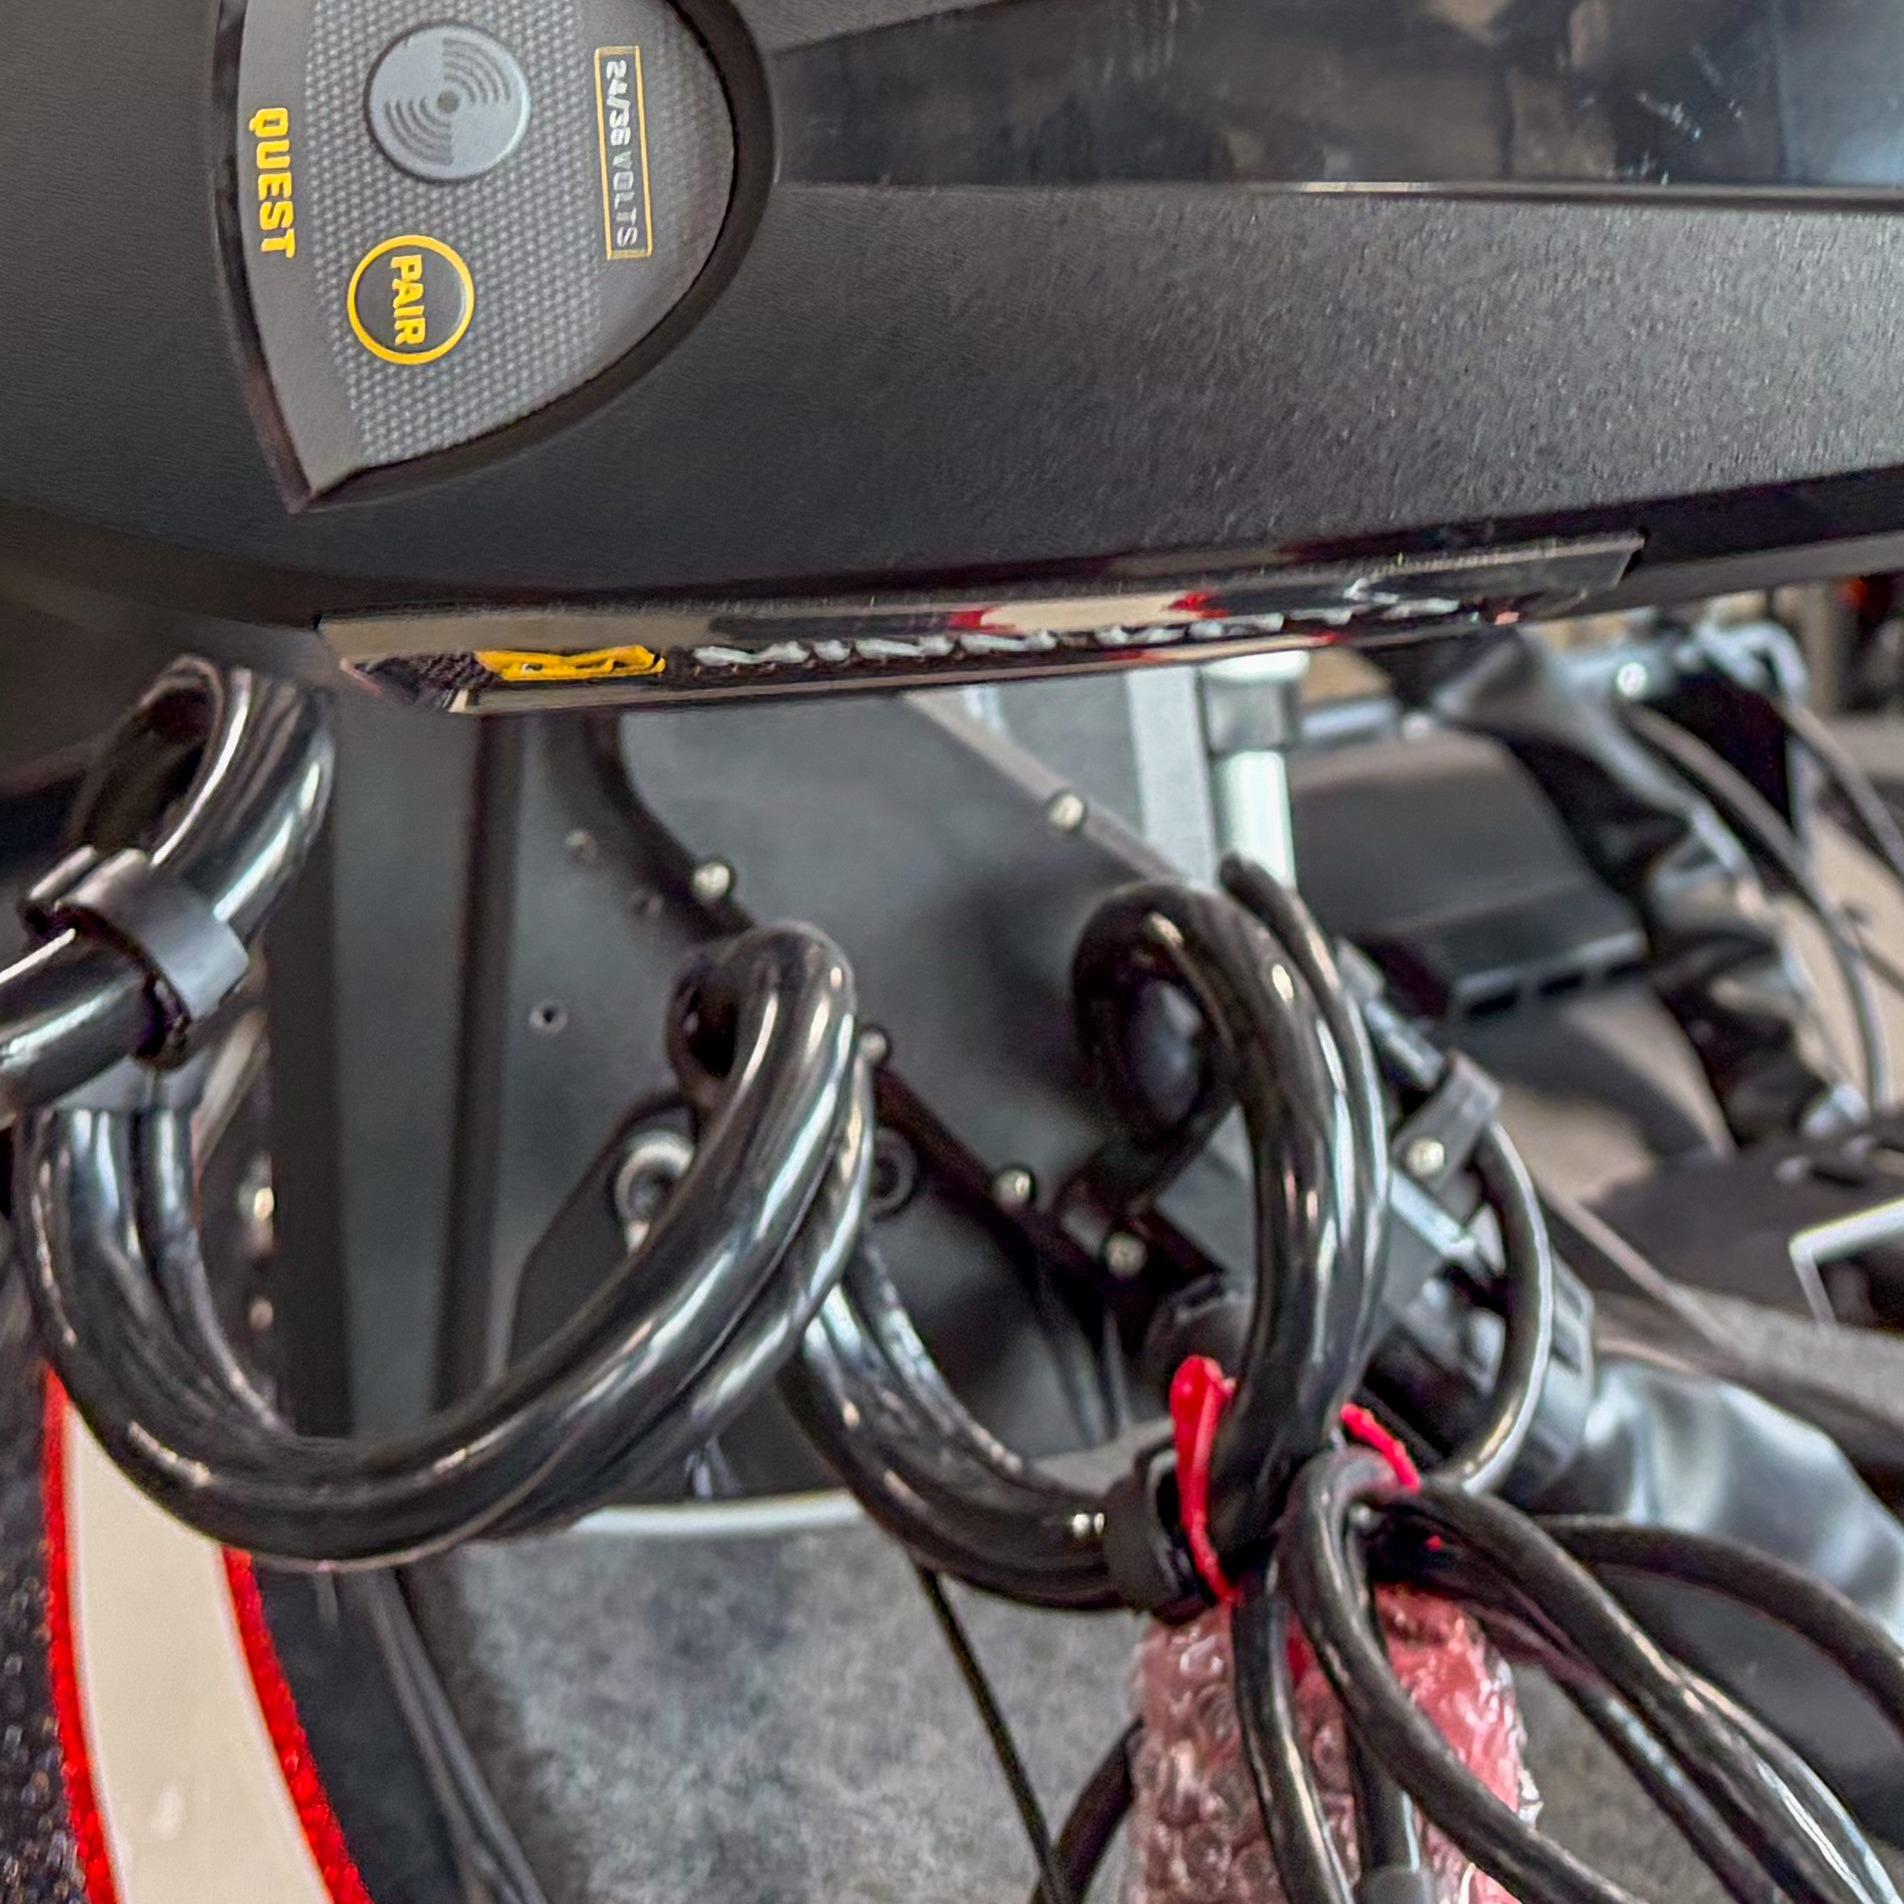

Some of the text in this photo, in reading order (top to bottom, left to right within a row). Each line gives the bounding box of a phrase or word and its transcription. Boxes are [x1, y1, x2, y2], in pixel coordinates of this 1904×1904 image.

[248, 107, 296, 259] QUEST
[606, 59, 639, 247] 24/36 VOLTS
[390, 254, 426, 346] PAIR
